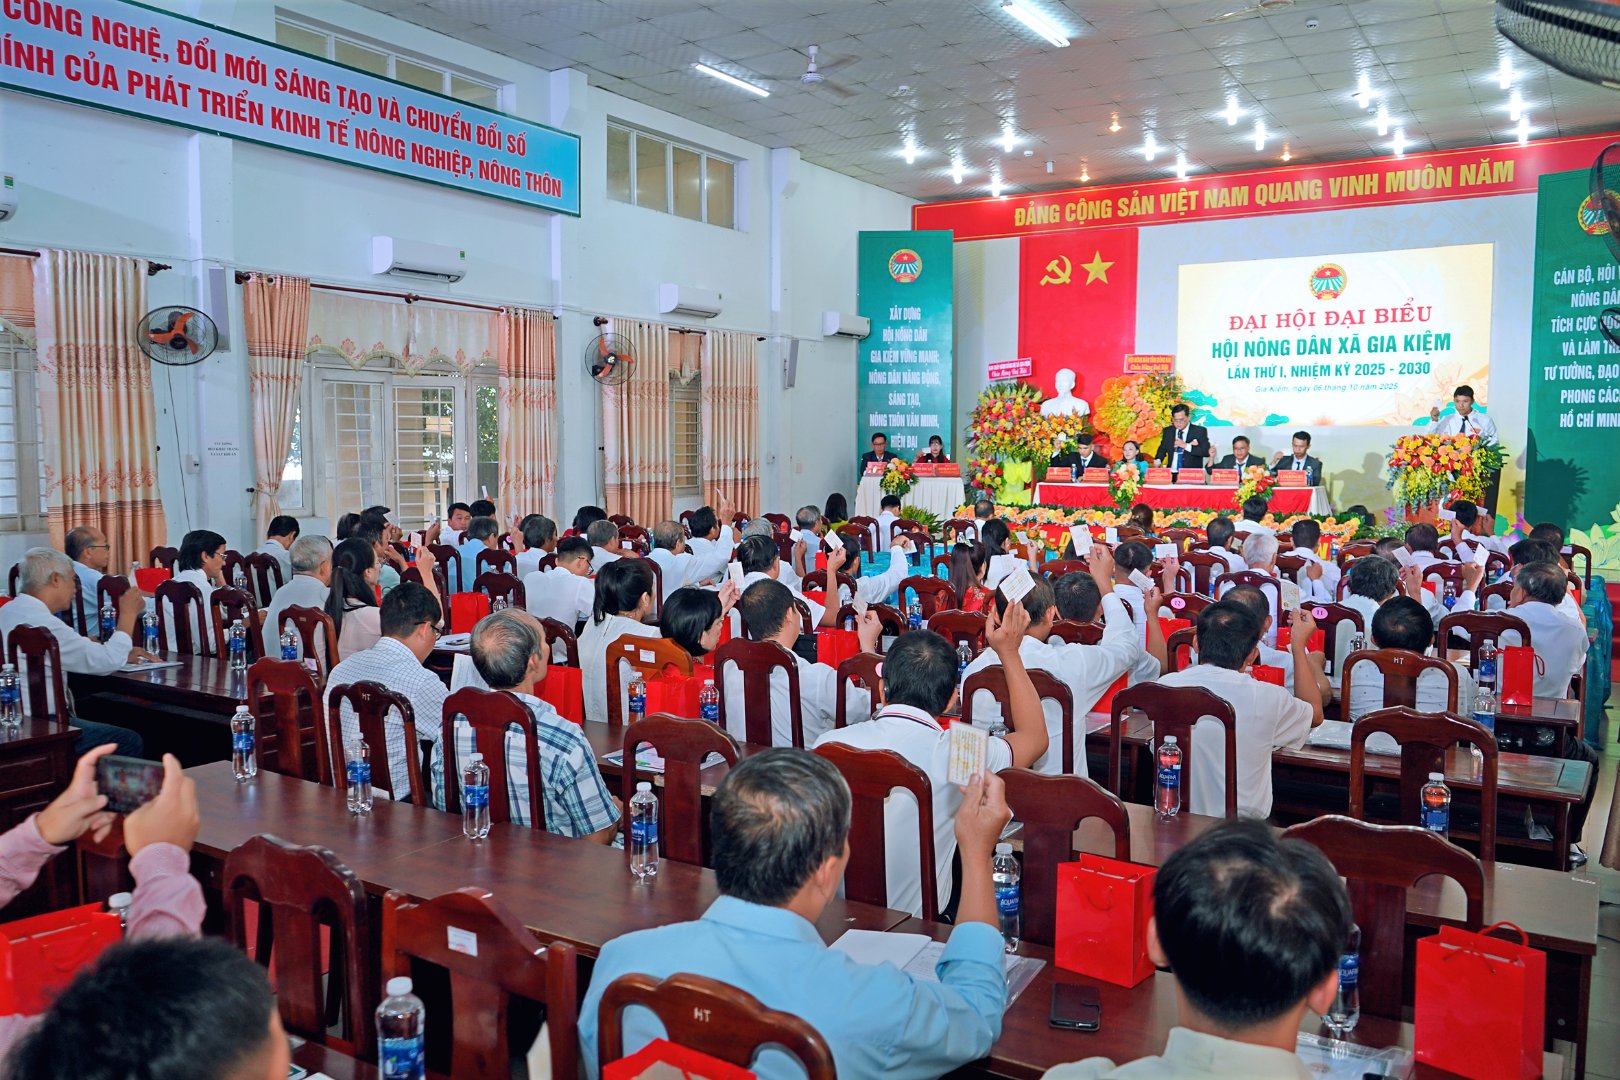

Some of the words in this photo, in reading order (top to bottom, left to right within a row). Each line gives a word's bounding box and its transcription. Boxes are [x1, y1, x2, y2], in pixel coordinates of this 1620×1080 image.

[91, 15, 169, 63] NGHỆ,
[177, 37, 216, 73] ĐỔI
[225, 53, 267, 87] MỚI
[275, 67, 330, 104] SÁNG
[336, 85, 372, 115] TẠO
[377, 96, 401, 123] VÀ
[406, 106, 472, 142] CHUYỂN
[476, 122, 502, 150] ĐỔI
[507, 132, 527, 157] SỐ
[0, 33, 54, 76] ÍNH
[64, 51, 119, 91] CỦA
[128, 70, 191, 108] PHÁT
[198, 88, 264, 126] TRIỂN
[271, 106, 320, 140] KINH
[326, 118, 350, 146] TẾ
[355, 128, 405, 160] NÔNG
[411, 143, 474, 179] NGHIỆP,
[479, 159, 521, 188] NÔNG
[525, 171, 562, 198] THÔN
[1015, 200, 1060, 227] ĐẢNG
[1065, 198, 1112, 224] CỘNG
[1117, 190, 1155, 217] SẢN
[1159, 188, 1199, 215] VIỆT
[1204, 186, 1249, 209] NAM
[1255, 178, 1323, 206] QUANG
[1329, 173, 1378, 198] VINH
[1385, 163, 1453, 193] MUÔN
[1460, 158, 1515, 186] NĂM
[1553, 267, 1575, 285] CÁN
[1577, 265, 1594, 286] BỘ,
[1597, 263, 1615, 284] HỘI
[1571, 290, 1600, 308] NÔNG
[889, 305, 902, 320] XÂY
[1229, 314, 1267, 333] ĐẠI
[1276, 308, 1316, 331] HỘI
[1324, 310, 1366, 329] ĐẠI
[1374, 297, 1432, 323] BIỂU
[1551, 315, 1573, 333] TÍCH
[1576, 314, 1597, 334] CỰC
[1212, 338, 1238, 362] HỘI
[1244, 337, 1290, 357] NÔNG
[1297, 335, 1331, 355] DÂN
[1338, 333, 1361, 354] XÃ
[1368, 335, 1397, 353] GIA
[1403, 330, 1451, 356] KIỆM
[1562, 338, 1575, 356] VÀ
[1578, 337, 1600, 355] LÀM
[1254, 364, 1277, 378] THỨ
[1291, 362, 1331, 380] NHIỆM
[1355, 363, 1385, 376] 2025
[1398, 362, 1430, 375] 2030
[1544, 365, 1558, 380] TƯ
[1559, 361, 1595, 381] TƯỞNG,
[1597, 364, 1620, 382] ĐẠO
[1560, 389, 1596, 403] PHONG
[1598, 385, 1620, 403] CÁC
[1560, 409, 1574, 427] HỒ
[1576, 410, 1594, 427] CHÍ
[1393, 656, 1404, 665] HT
[694, 1006, 712, 1023] HT
